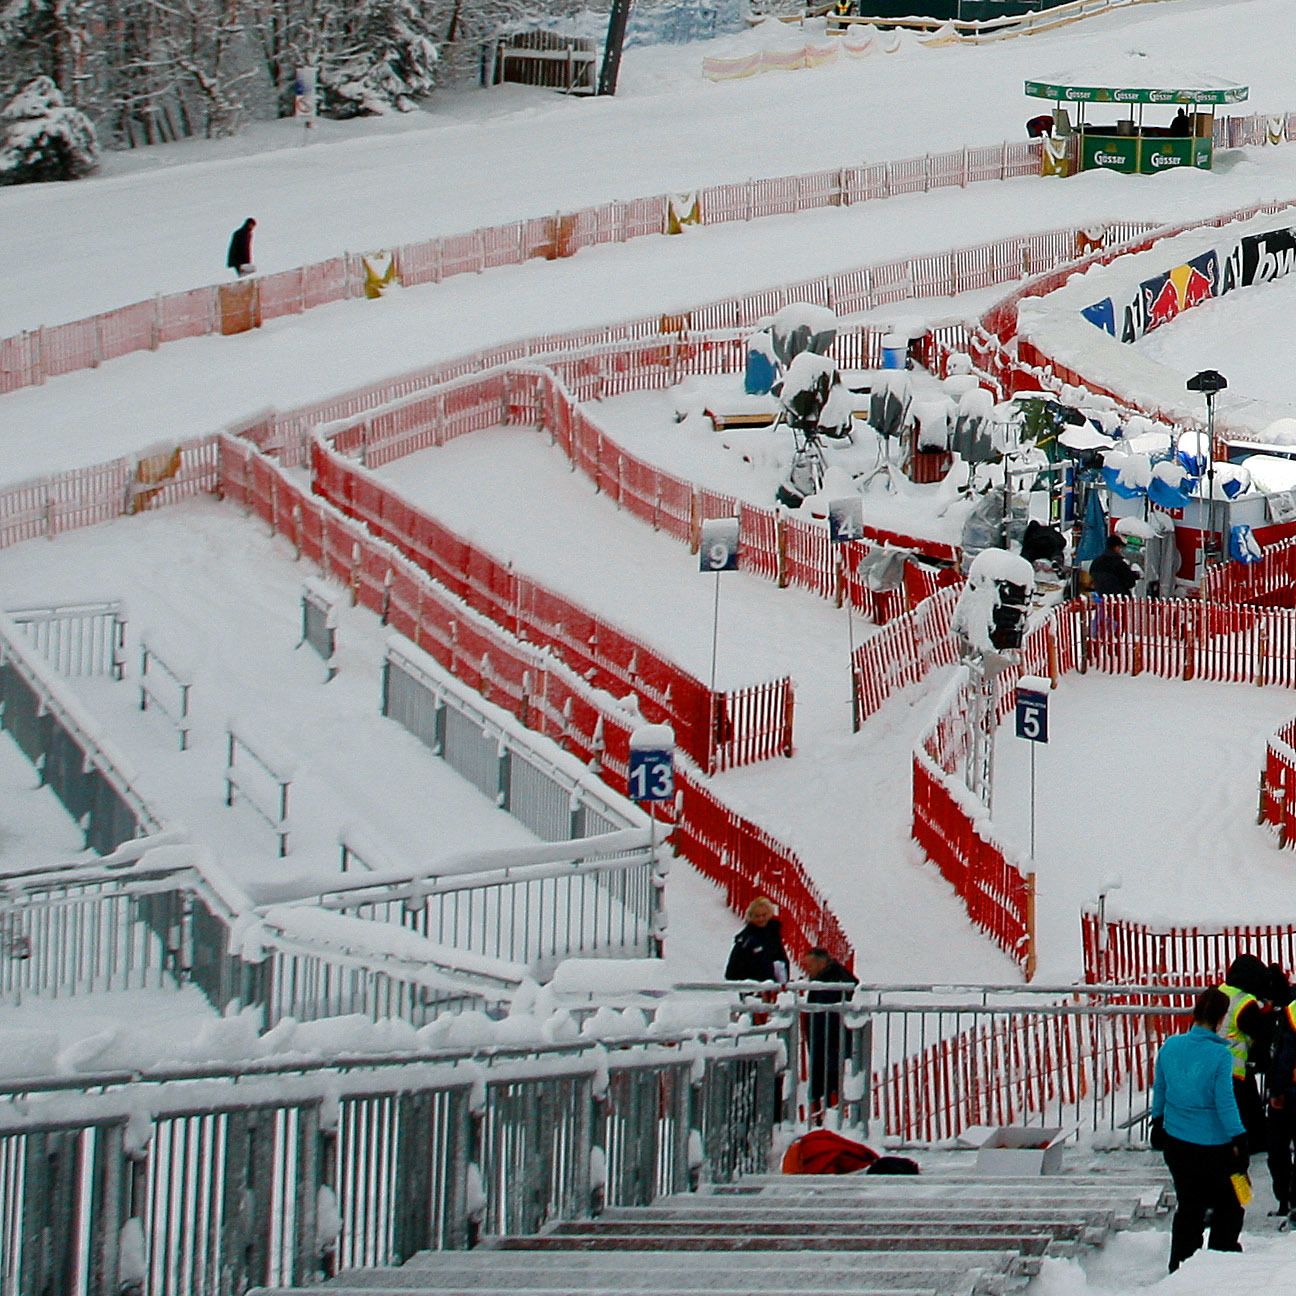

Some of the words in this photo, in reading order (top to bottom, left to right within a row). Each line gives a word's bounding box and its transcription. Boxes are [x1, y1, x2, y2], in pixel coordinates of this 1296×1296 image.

[1221, 245, 1241, 296] A1
[1121, 293, 1141, 344] A1
[838, 515, 856, 539] 4
[709, 543, 729, 569] 9
[1023, 707, 1040, 738] 5
[631, 764, 673, 797] 13
